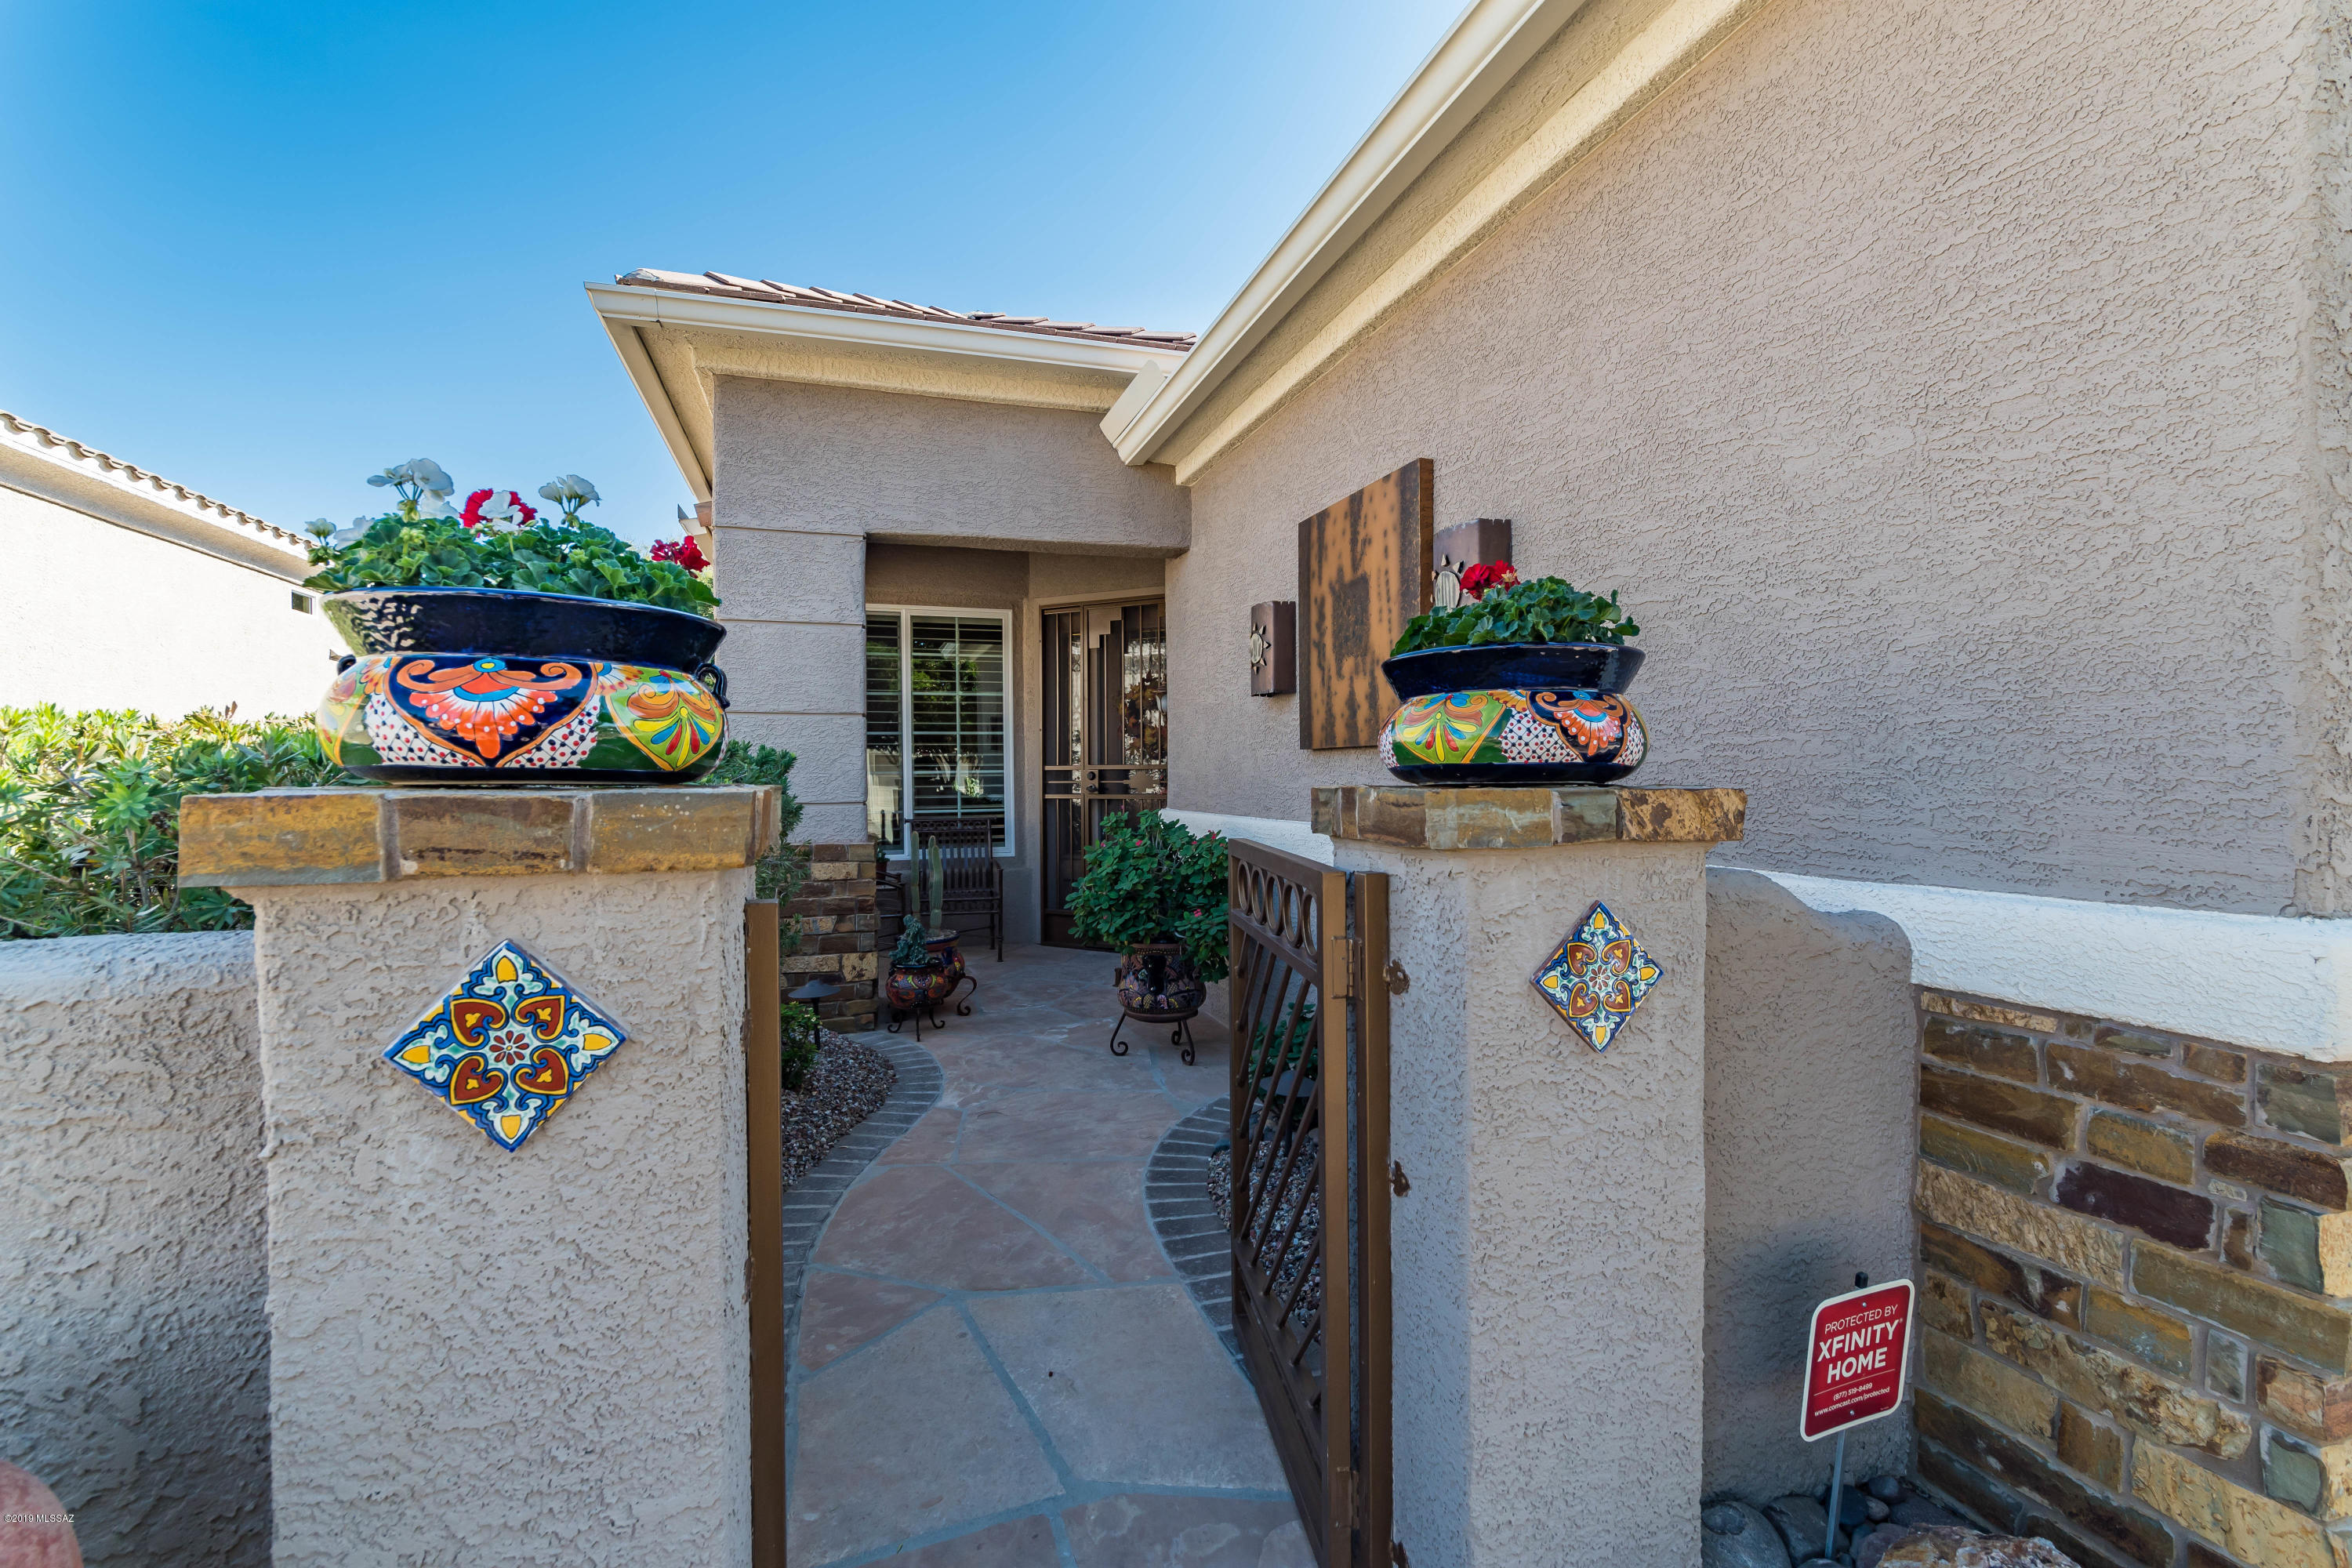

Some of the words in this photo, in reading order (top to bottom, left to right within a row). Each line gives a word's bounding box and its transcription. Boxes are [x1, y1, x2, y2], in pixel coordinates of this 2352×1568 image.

[1824, 1308, 1882, 1334] PROTECTED
[1884, 1305, 1898, 1317] BY
[1827, 1347, 1888, 1384] HOME
[1814, 1386, 1890, 1417] www.comcast.com/protected
[1833, 1390, 1847, 1401] (877)
